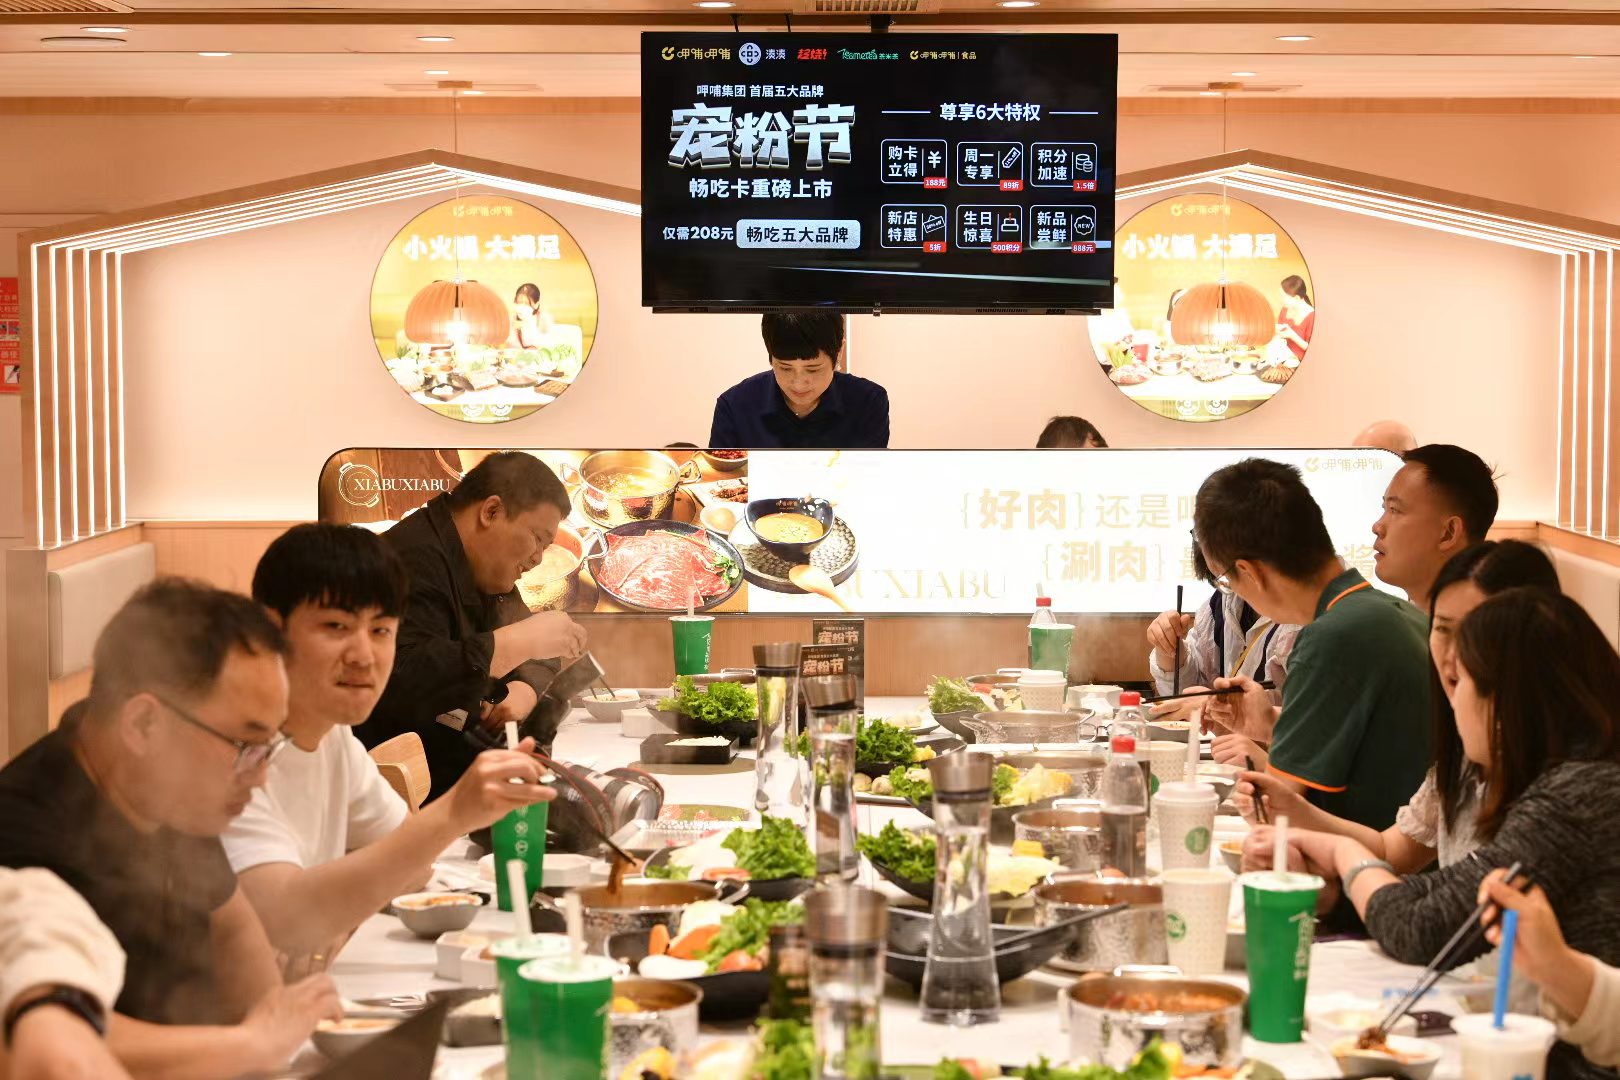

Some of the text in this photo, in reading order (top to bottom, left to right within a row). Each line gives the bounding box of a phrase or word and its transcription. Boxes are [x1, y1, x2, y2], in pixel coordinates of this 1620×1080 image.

[961, 50, 977, 61] 食品
[696, 84, 824, 98] 呷哺集团 首届五大品牌
[939, 102, 1041, 122] 尊享6大特权
[668, 102, 856, 171] 宠粉节
[888, 145, 918, 161] 购卡
[964, 148, 994, 163] 周一
[1037, 149, 1068, 164] 积分
[888, 162, 918, 178] 立得
[964, 165, 994, 180] 专享
[1037, 166, 1068, 181] 加速
[689, 177, 833, 199] 畅吃卡重磅上市
[925, 179, 946, 187] 188元
[1003, 181, 1020, 189] 89折
[1076, 181, 1095, 190] 1.5倍
[887, 211, 918, 226] 新店
[963, 211, 993, 226] 生日
[1036, 211, 1067, 226] 新品
[662, 226, 734, 241] 仅需208元
[746, 226, 850, 243] 畅吃五大品牌
[887, 228, 918, 243] 特惠
[963, 228, 993, 243] 惊喜
[1036, 228, 1067, 243] 尝鲜
[929, 243, 942, 251] 5折
[992, 243, 1020, 252] 500积分
[354, 478, 451, 491] XIABUXIABU
